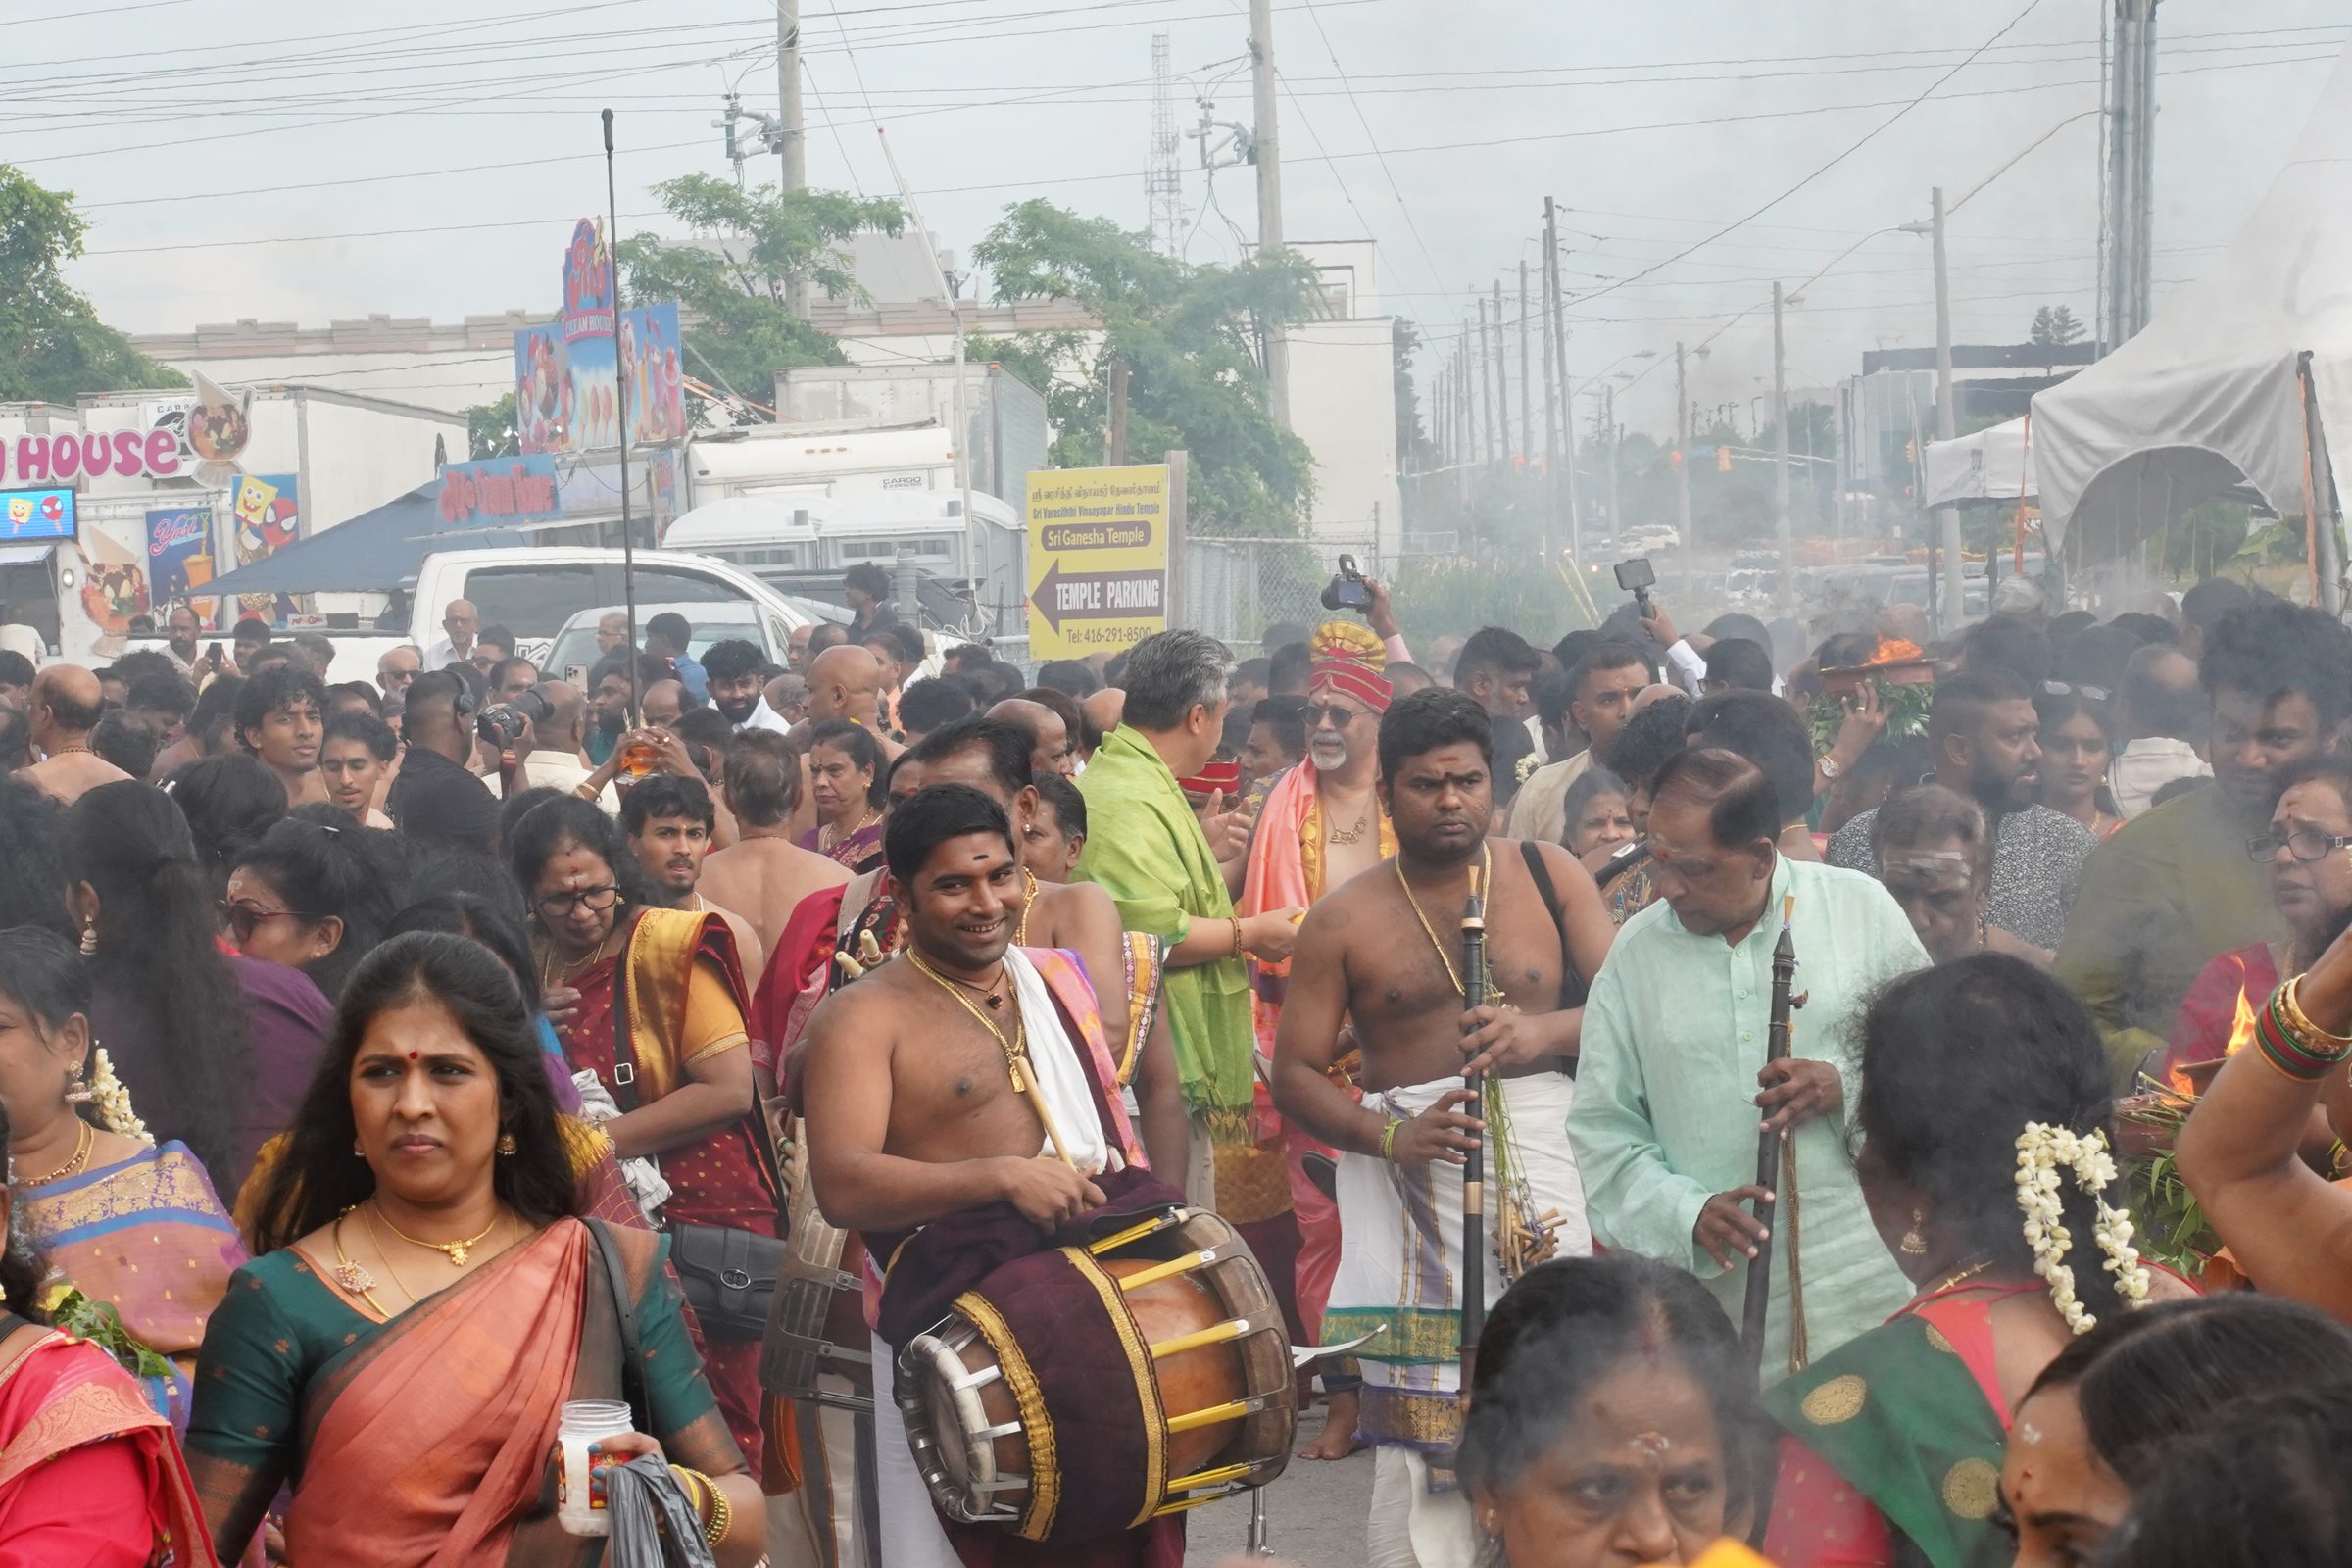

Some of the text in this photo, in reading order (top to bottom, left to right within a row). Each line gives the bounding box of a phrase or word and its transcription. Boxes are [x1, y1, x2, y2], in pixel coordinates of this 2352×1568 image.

[589, 315, 612, 333] HOUSE
[883, 476, 922, 485] CARGO
[1033, 508, 1042, 519] Sri
[1115, 503, 1135, 516] Hindu
[1137, 501, 1160, 516] Temple
[1048, 527, 1145, 547] Sri Ganesha Temple
[1056, 579, 1159, 610] TEMPLE PARKING
[1067, 628, 1083, 644] Tel:
